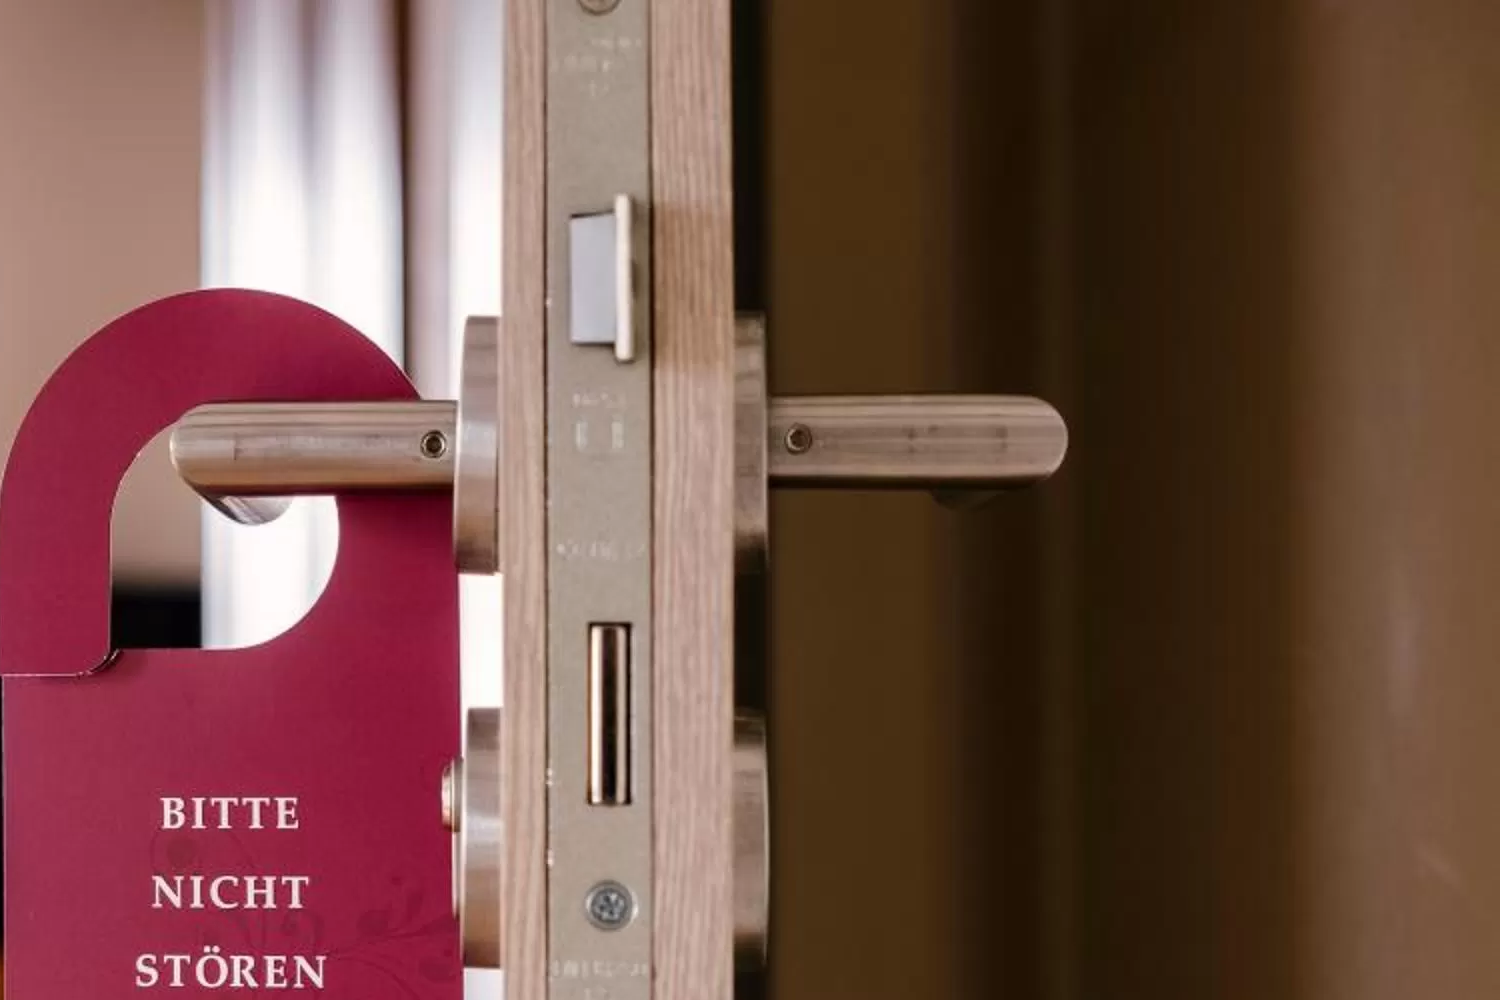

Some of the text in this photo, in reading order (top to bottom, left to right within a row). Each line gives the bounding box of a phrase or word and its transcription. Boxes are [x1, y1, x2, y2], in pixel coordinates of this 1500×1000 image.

[160, 797, 299, 829] BITTE
[152, 875, 310, 909] NICHT
[135, 945, 327, 988] STÖREN
